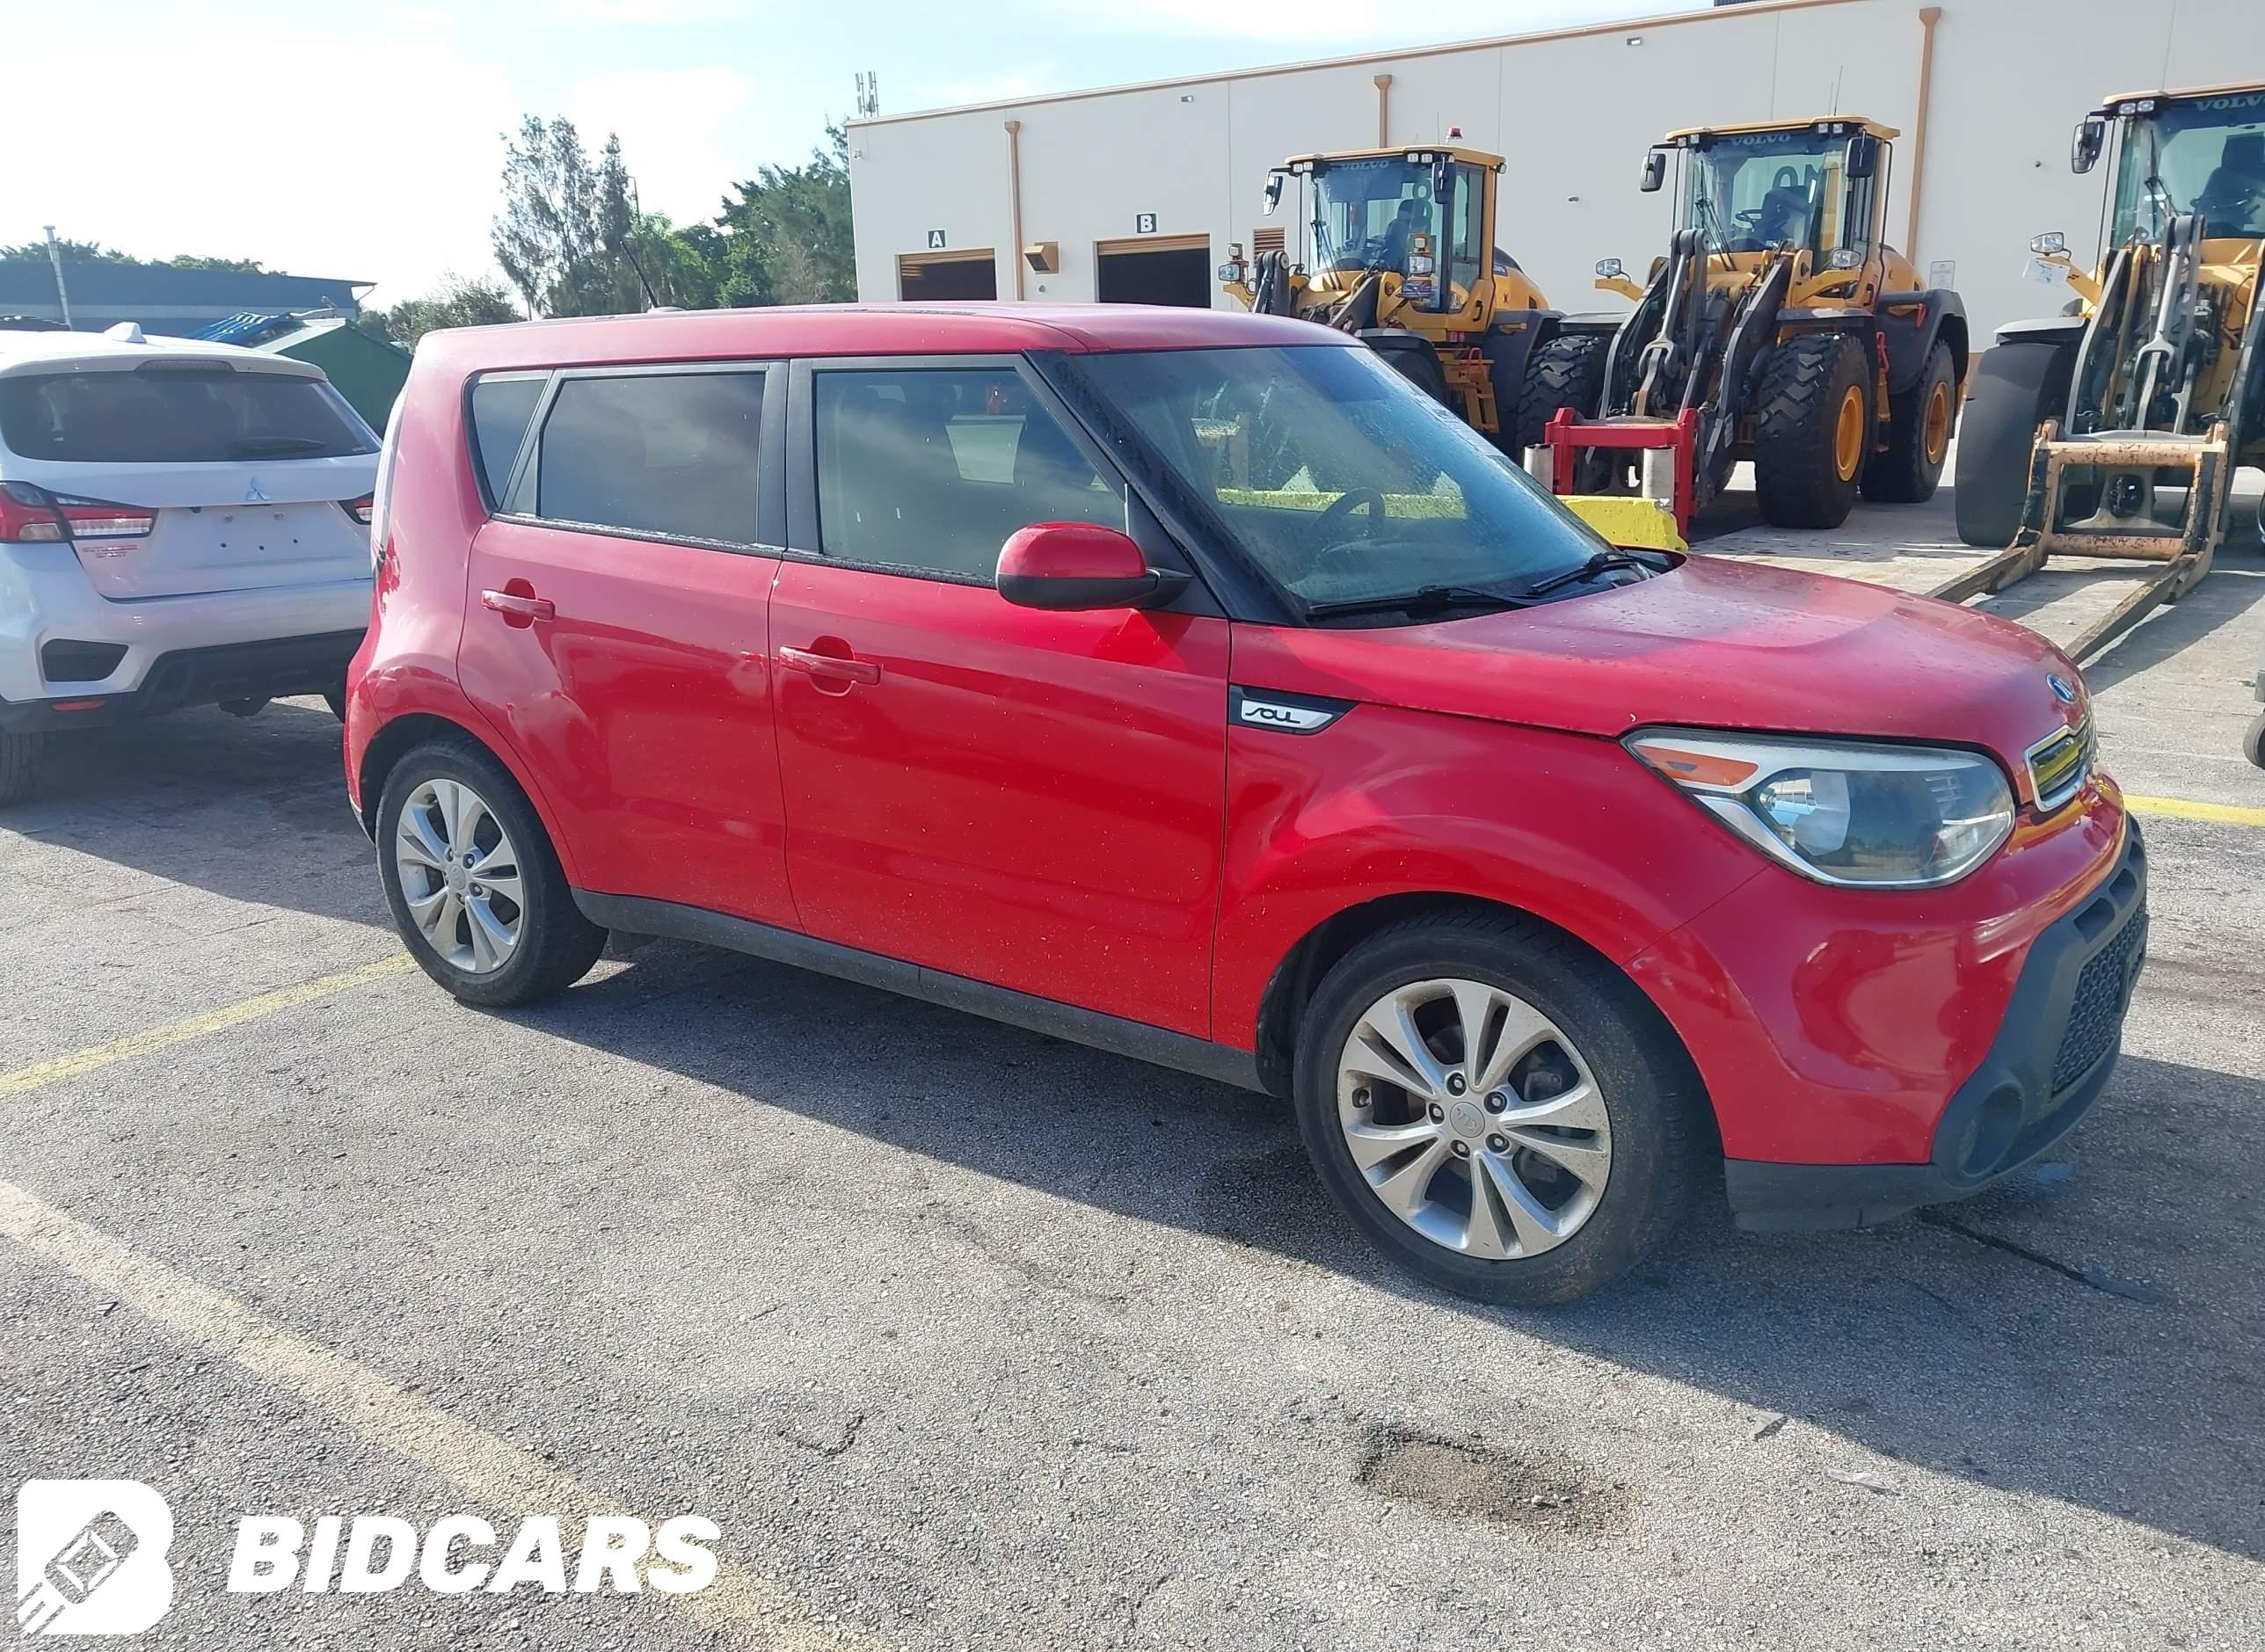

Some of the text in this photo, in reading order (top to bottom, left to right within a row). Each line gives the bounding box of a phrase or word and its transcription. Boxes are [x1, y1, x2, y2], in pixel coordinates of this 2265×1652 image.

[2195, 94, 2265, 112] VOLV
[1730, 133, 1792, 146] VOLVO
[1341, 160, 1389, 171] VOLVO
[1140, 215, 1153, 232] B
[931, 231, 943, 247] A
[1244, 707, 1300, 724] SOUL
